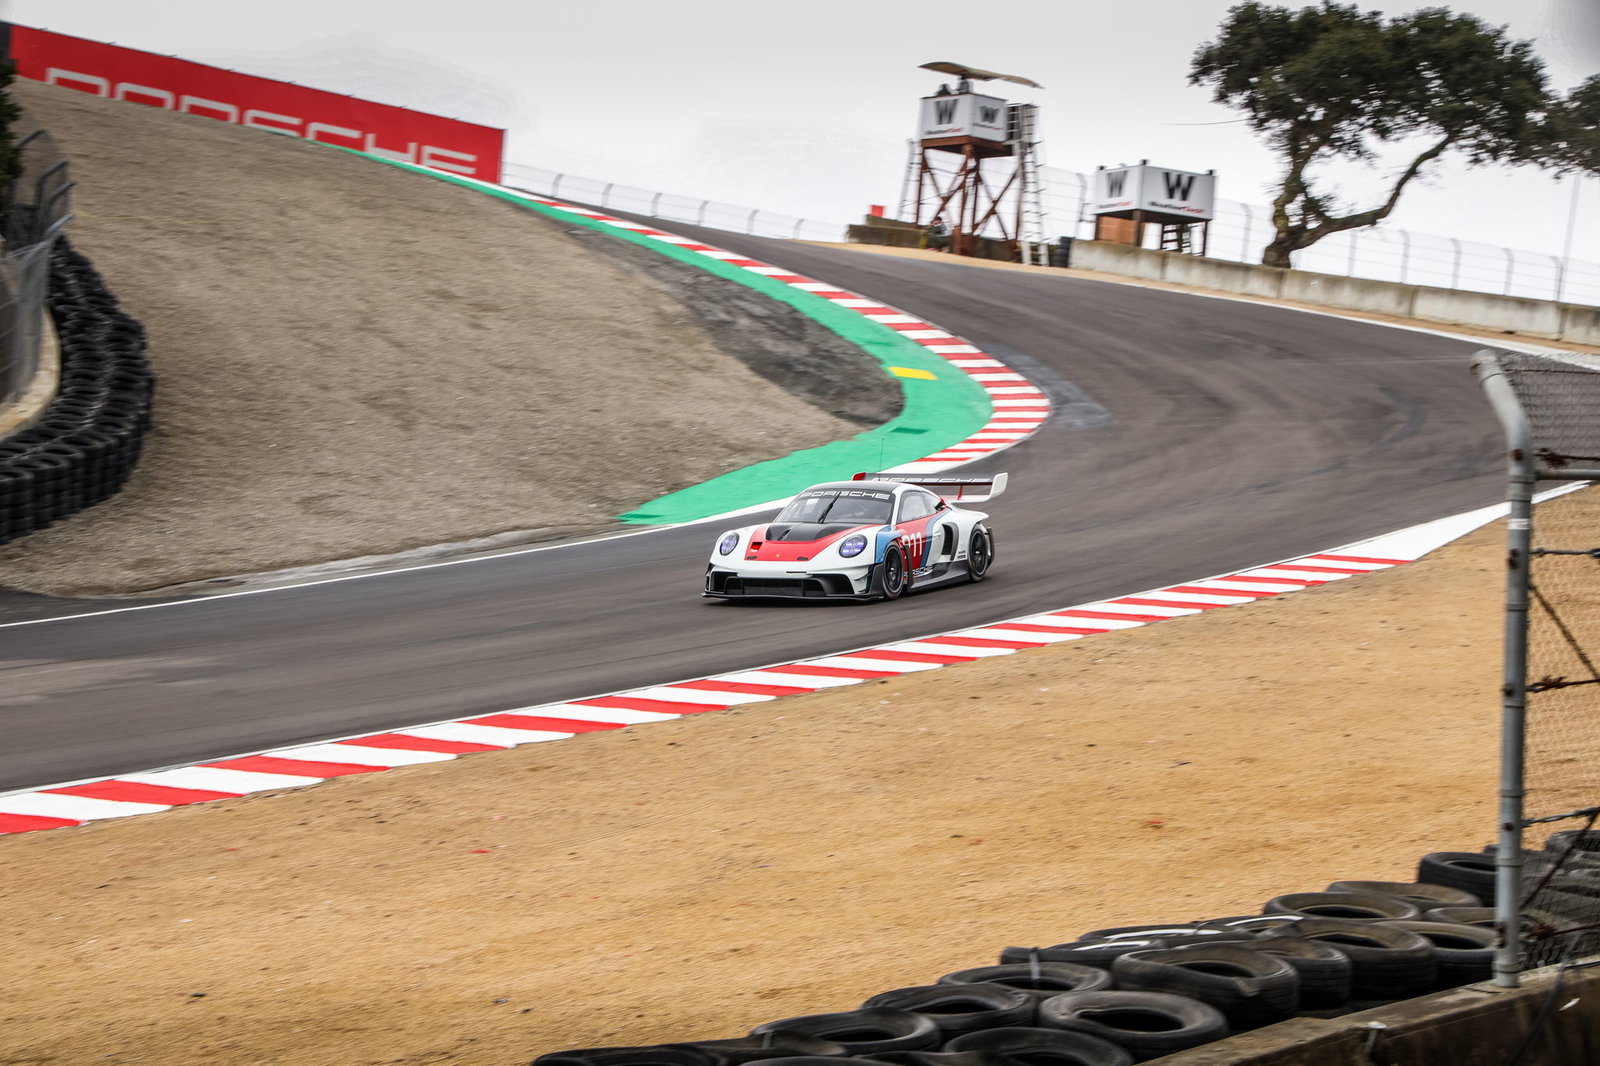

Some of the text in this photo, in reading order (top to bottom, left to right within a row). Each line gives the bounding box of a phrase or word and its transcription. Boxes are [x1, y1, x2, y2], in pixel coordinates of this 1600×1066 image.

[935, 98, 960, 125] W
[1107, 170, 1128, 198] W
[1162, 172, 1197, 201] W
[799, 490, 891, 500] PORSCHE
[901, 532, 922, 558] 911
